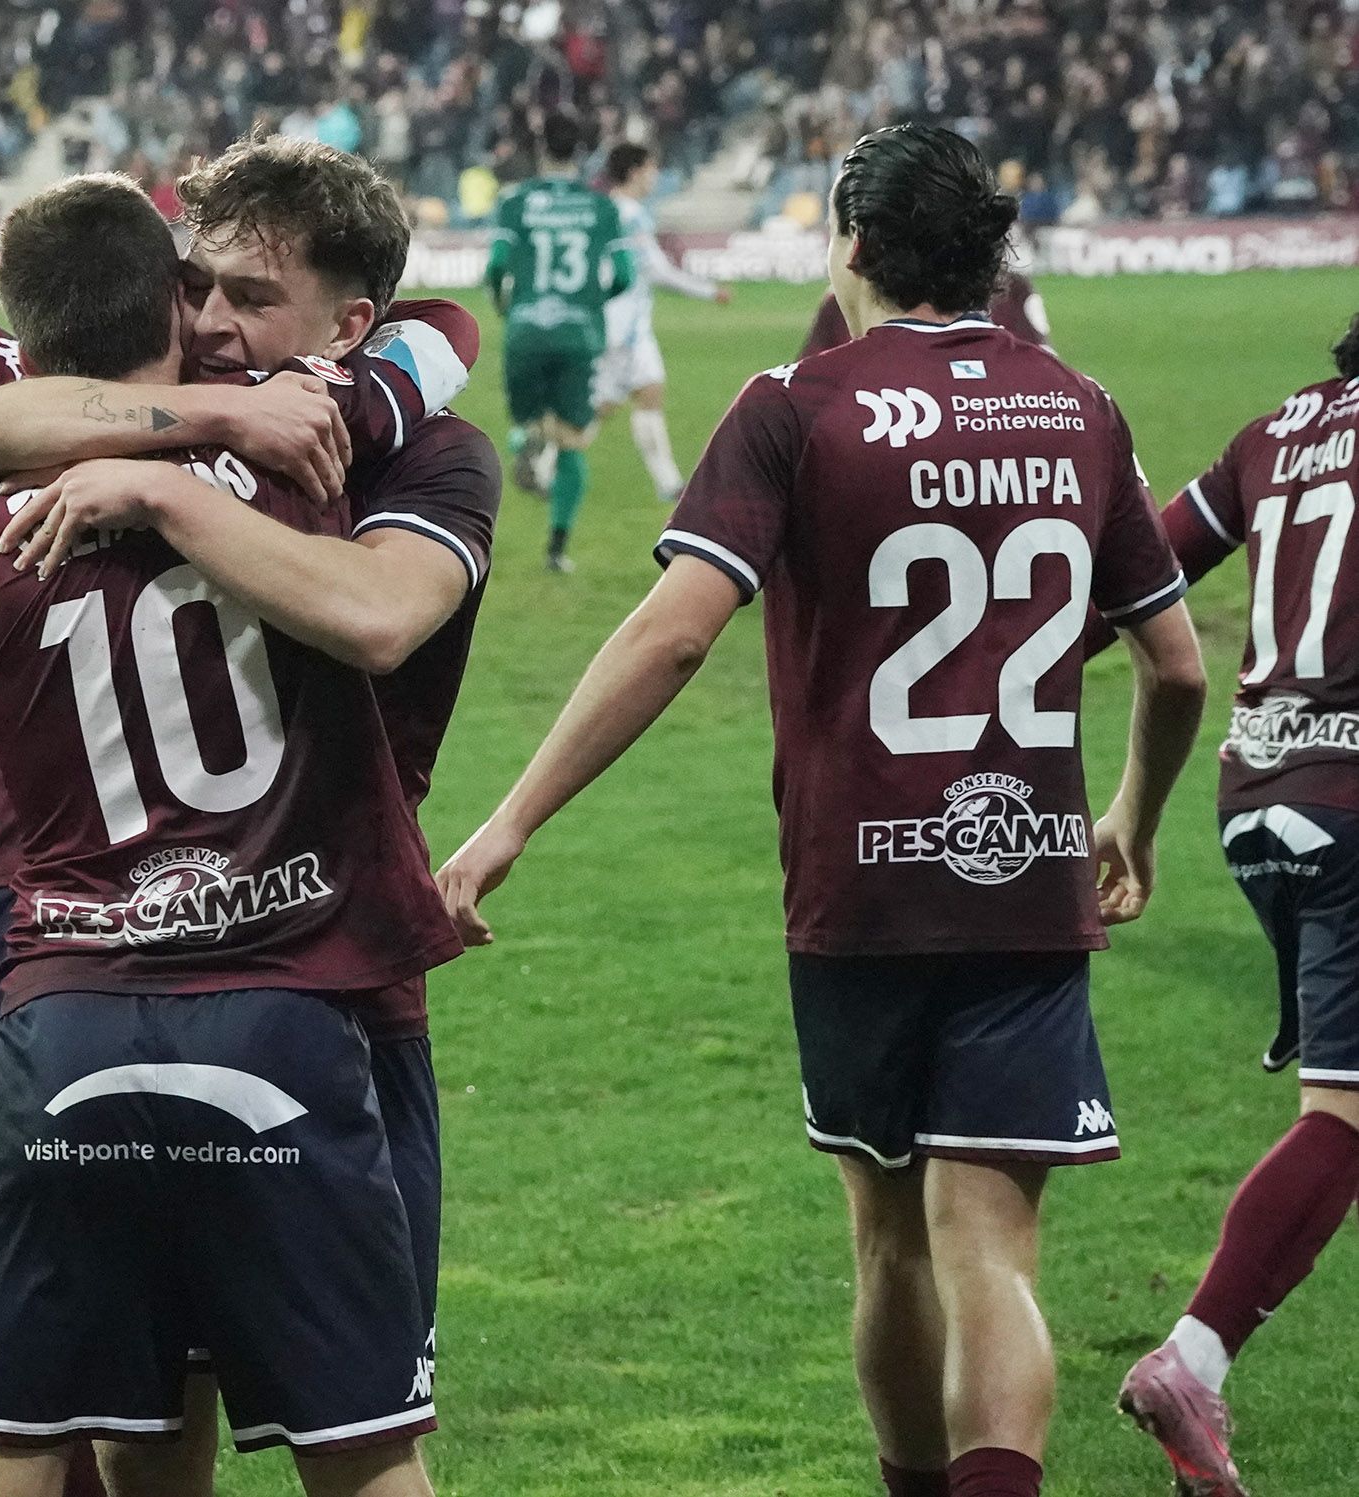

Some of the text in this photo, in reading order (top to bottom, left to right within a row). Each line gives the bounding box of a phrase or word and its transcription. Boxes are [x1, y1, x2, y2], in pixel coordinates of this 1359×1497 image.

[530, 231, 589, 294] 13
[951, 391, 1080, 415] Deputación
[955, 413, 1085, 431] Pontevedra
[909, 457, 1082, 509] COMPA
[1244, 480, 1356, 685] 17
[869, 518, 1093, 755] 22
[39, 564, 286, 845] 10
[943, 773, 1034, 801] CONSERVAS
[858, 814, 1089, 864] PESCAMAR
[129, 847, 230, 884] CONSERVAS
[36, 852, 333, 939] PESCAMAR
[166, 1142, 300, 1164] vedra.com
